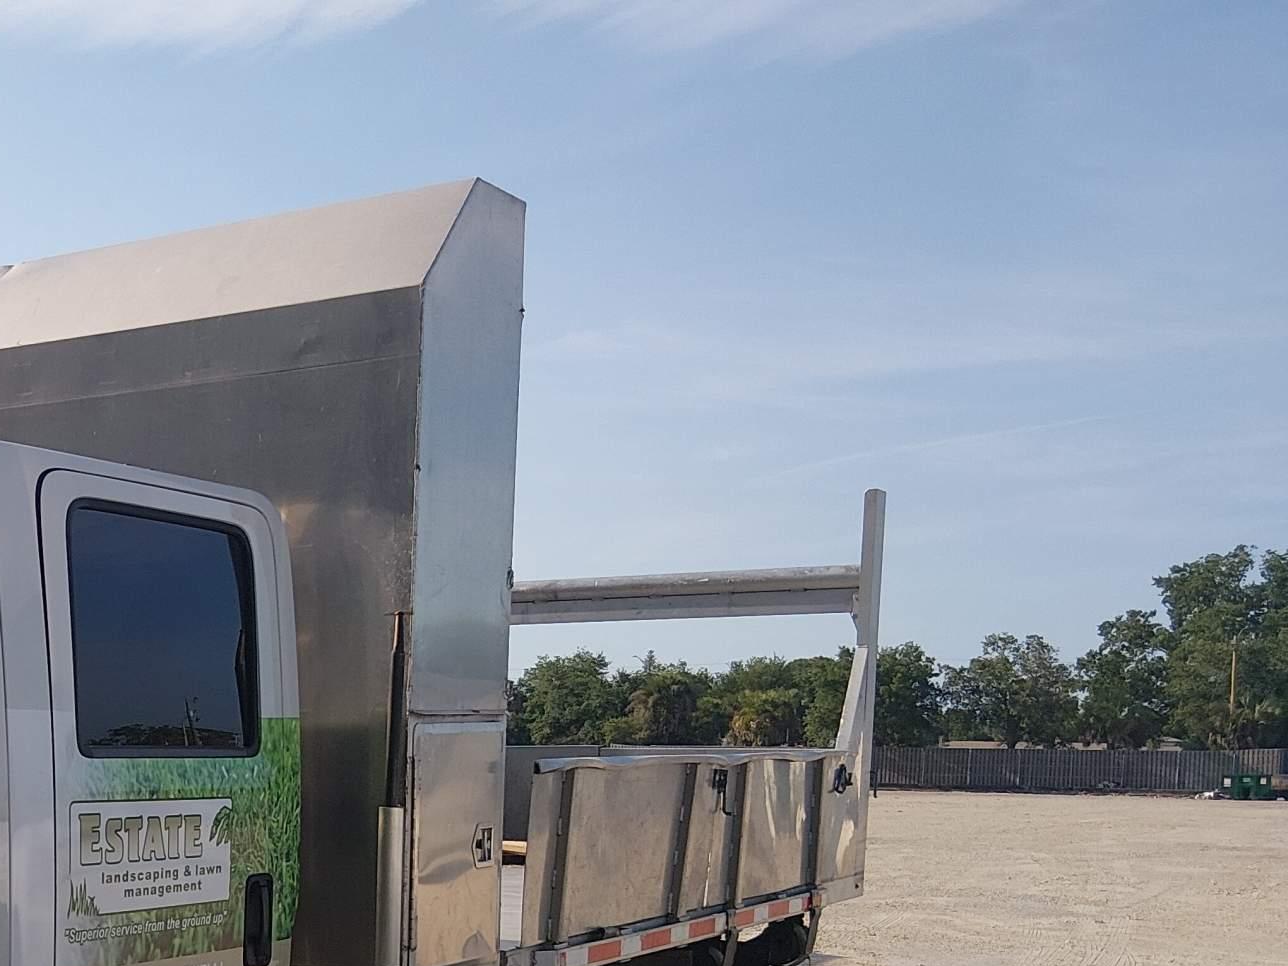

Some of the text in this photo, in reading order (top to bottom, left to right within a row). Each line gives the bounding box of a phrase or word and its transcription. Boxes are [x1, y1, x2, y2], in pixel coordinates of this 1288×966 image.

[101, 863, 222, 884] landscaping & lawn
[123, 880, 202, 898] management
[110, 922, 143, 937] service
[144, 919, 165, 933] from
[166, 918, 180, 930] the
[182, 914, 211, 929] ground
